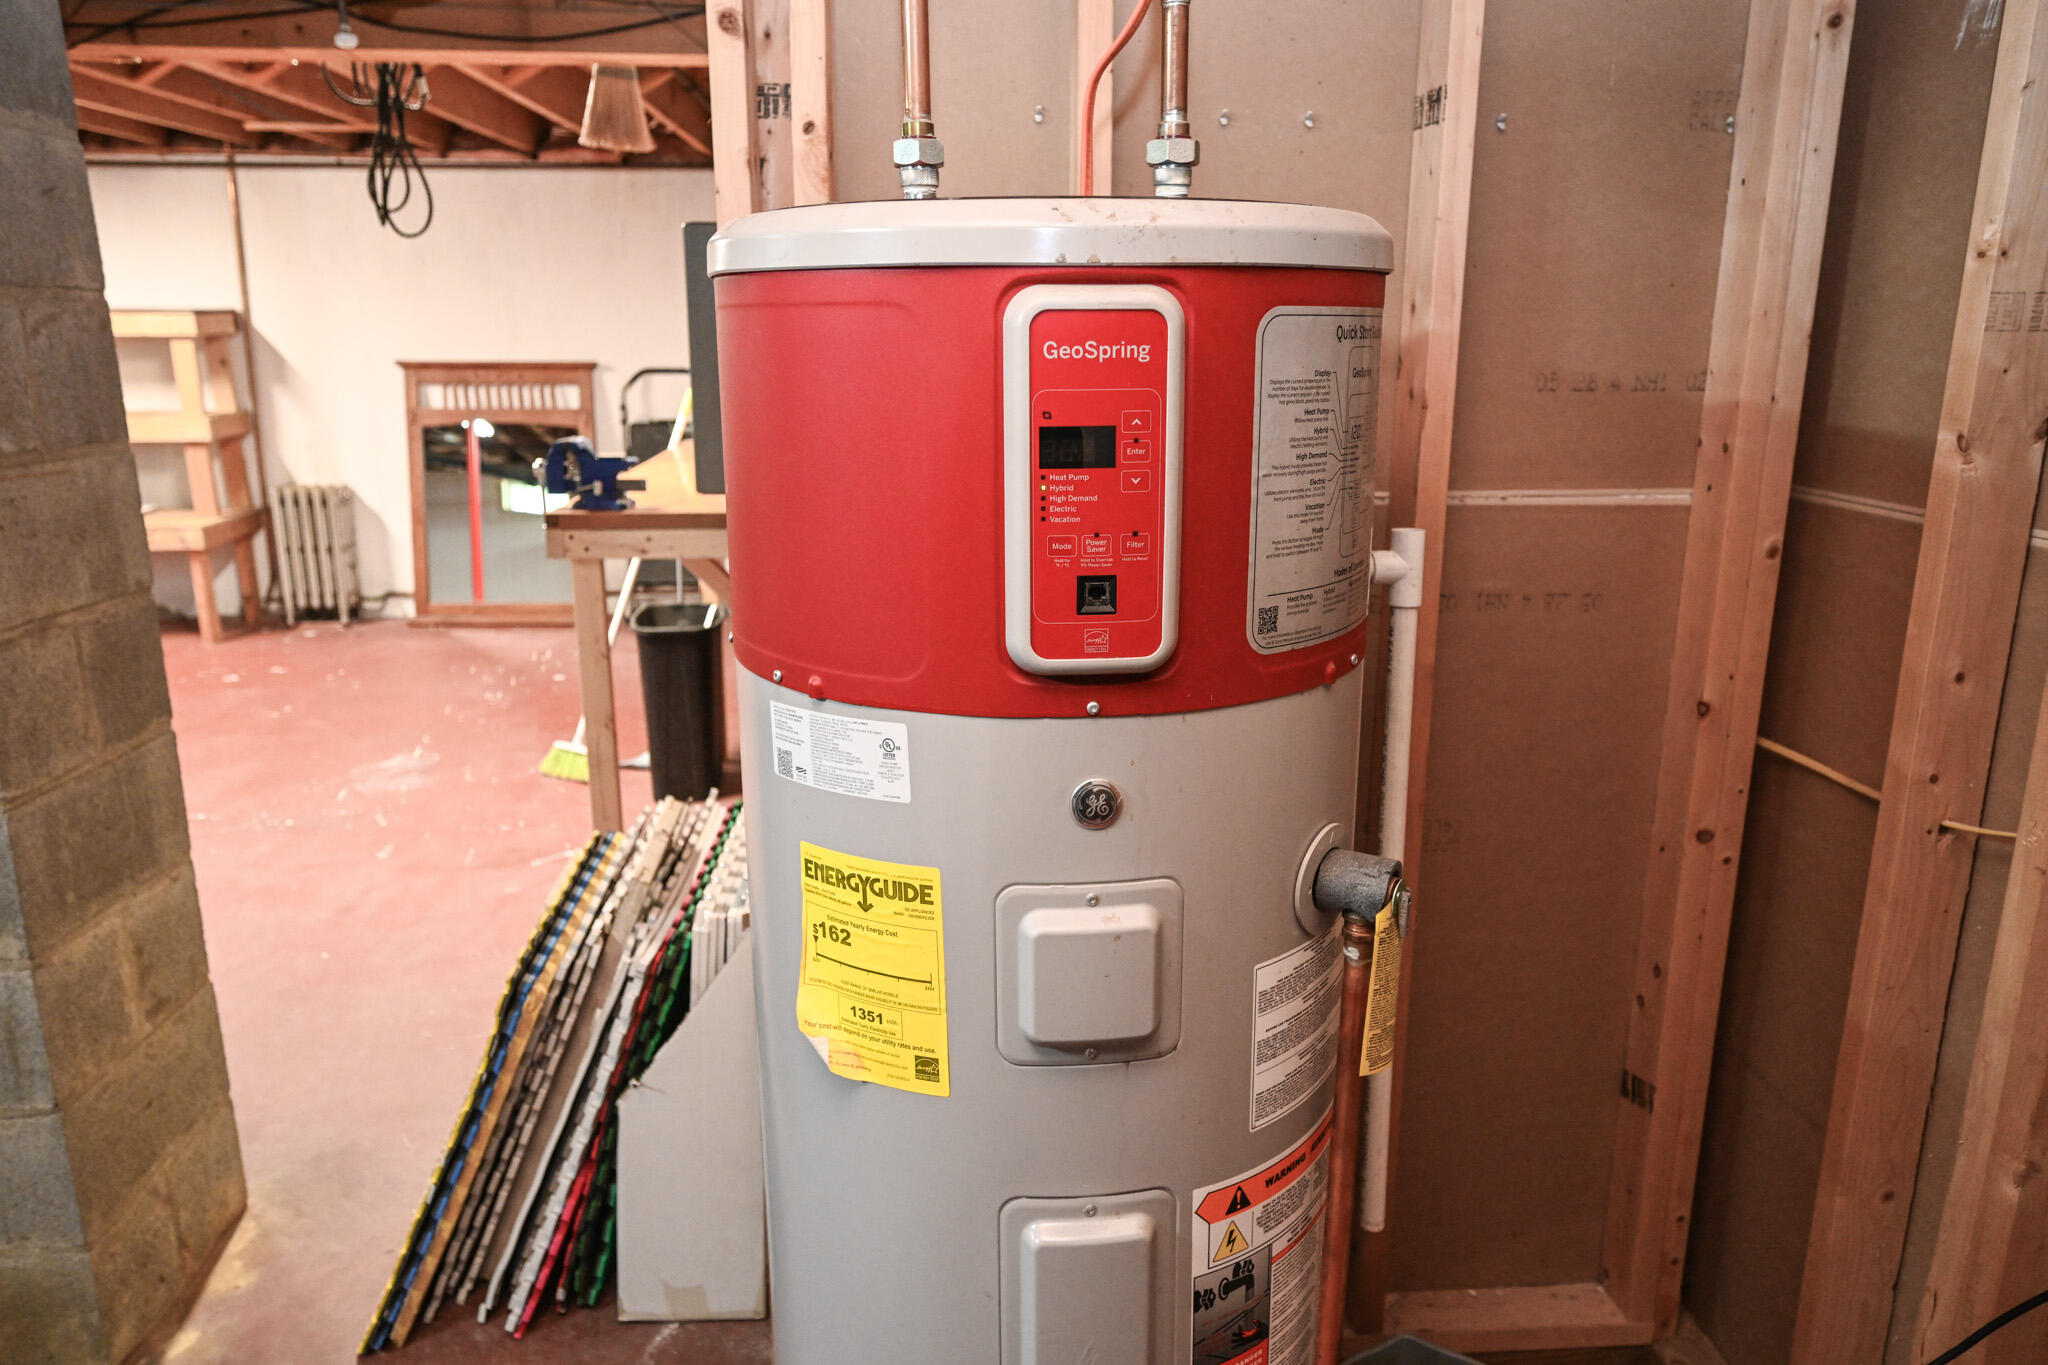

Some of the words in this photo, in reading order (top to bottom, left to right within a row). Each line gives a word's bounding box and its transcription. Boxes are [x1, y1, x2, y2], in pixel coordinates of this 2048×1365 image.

[1336, 324, 1358, 343] Quick
[1043, 340, 1151, 363] GeoSpring
[1314, 369, 1331, 377] Display
[1304, 408, 1316, 416] Heat
[1314, 426, 1328, 434] Hybrid
[1296, 452, 1308, 462] High
[1308, 451, 1328, 460] Demand
[1068, 474, 1090, 483] Pump
[1310, 478, 1327, 486] Electric
[1050, 484, 1074, 493] Hybrid
[1050, 495, 1067, 503] High
[1305, 502, 1325, 510] Vacation
[1312, 527, 1324, 535] Mode
[1126, 541, 1145, 549] Filter
[1300, 594, 1314, 602] Pump
[804, 857, 934, 912] ENERGYGUIDE
[827, 914, 849, 927] Estimated
[850, 921, 866, 932] Yearly
[866, 925, 884, 936] Energy
[885, 929, 898, 938] Cost
[813, 921, 852, 947] $162
[850, 1005, 883, 1025] 1351
[804, 1020, 818, 1028] Your
[818, 1022, 832, 1030] cost
[832, 1024, 842, 1032] will
[843, 1025, 860, 1038] depend
[861, 1032, 868, 1040] on
[868, 1034, 882, 1044] your
[882, 1038, 896, 1048] utility
[897, 1042, 911, 1050] rates
[912, 1045, 923, 1053] and
[924, 1047, 936, 1055] use.
[1265, 1152, 1306, 1188] WARNING
